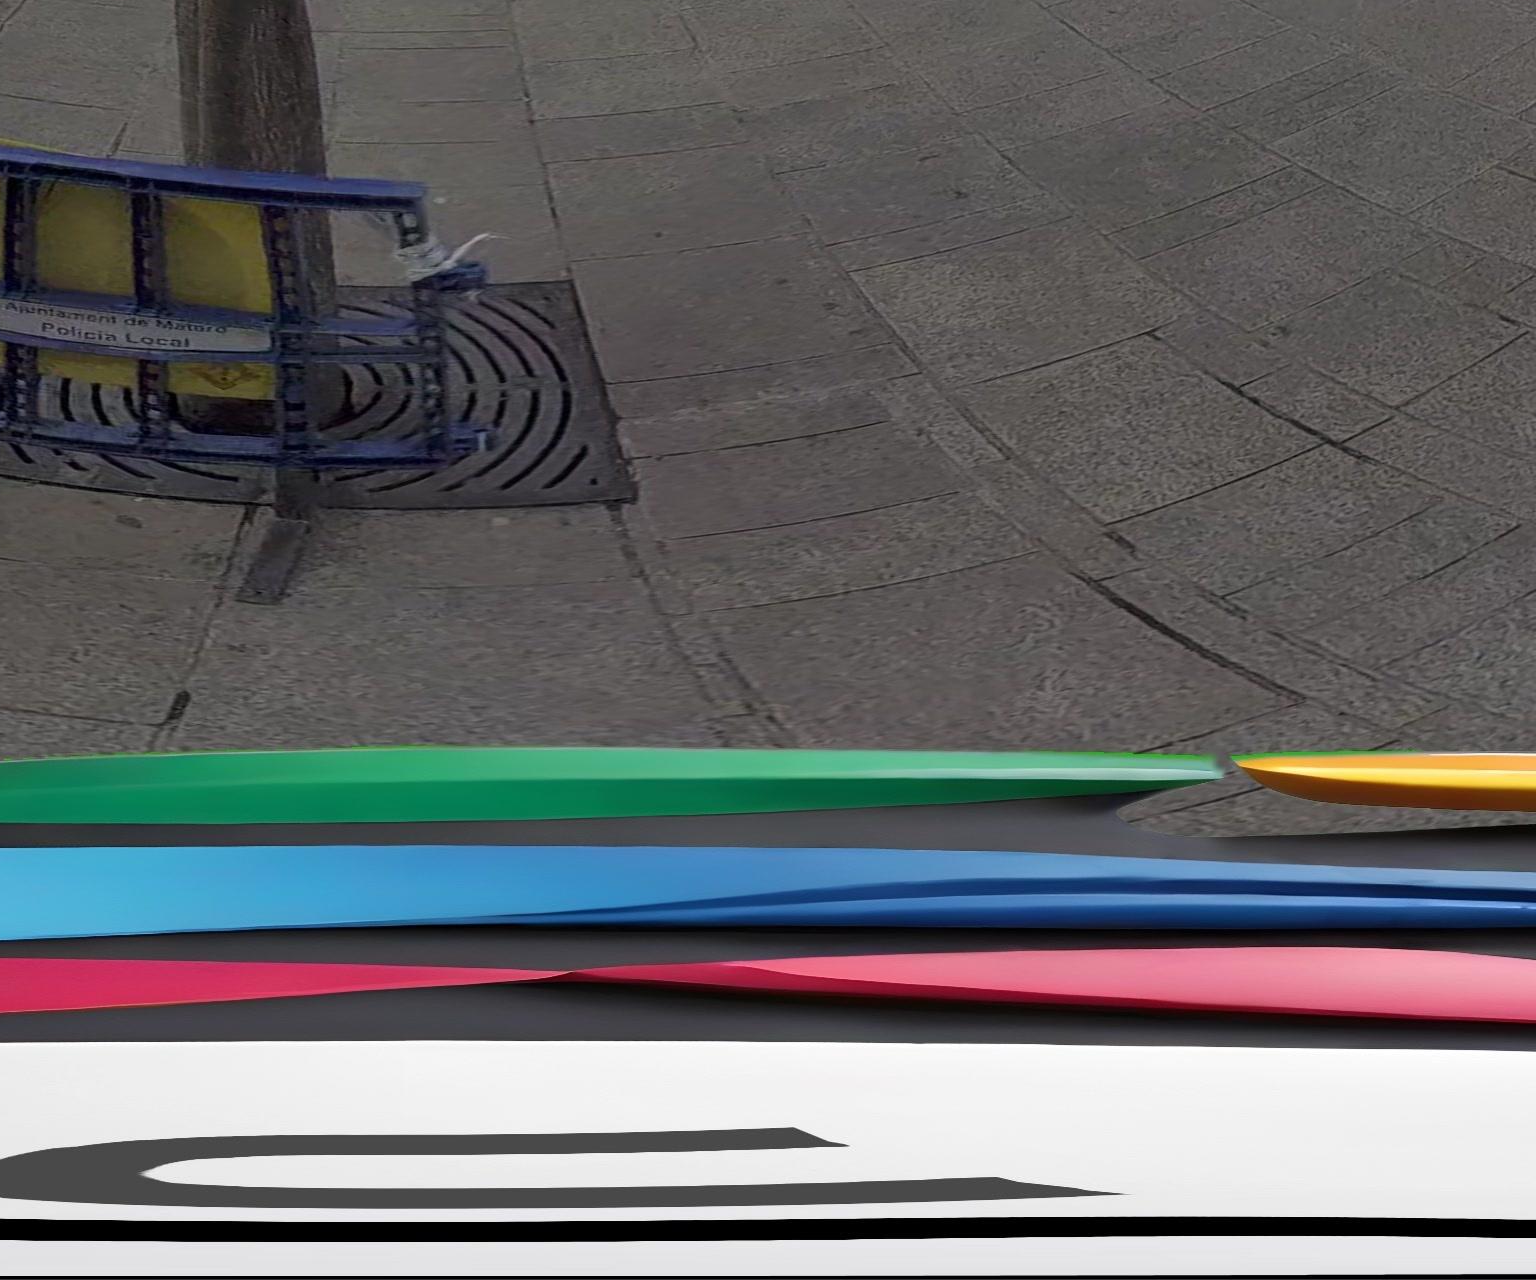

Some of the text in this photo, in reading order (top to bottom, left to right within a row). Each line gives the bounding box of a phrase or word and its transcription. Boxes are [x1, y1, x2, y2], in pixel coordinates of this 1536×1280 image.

[3, 301, 229, 335] Ajuntament de Mataró
[40, 321, 191, 349] Policia Local
